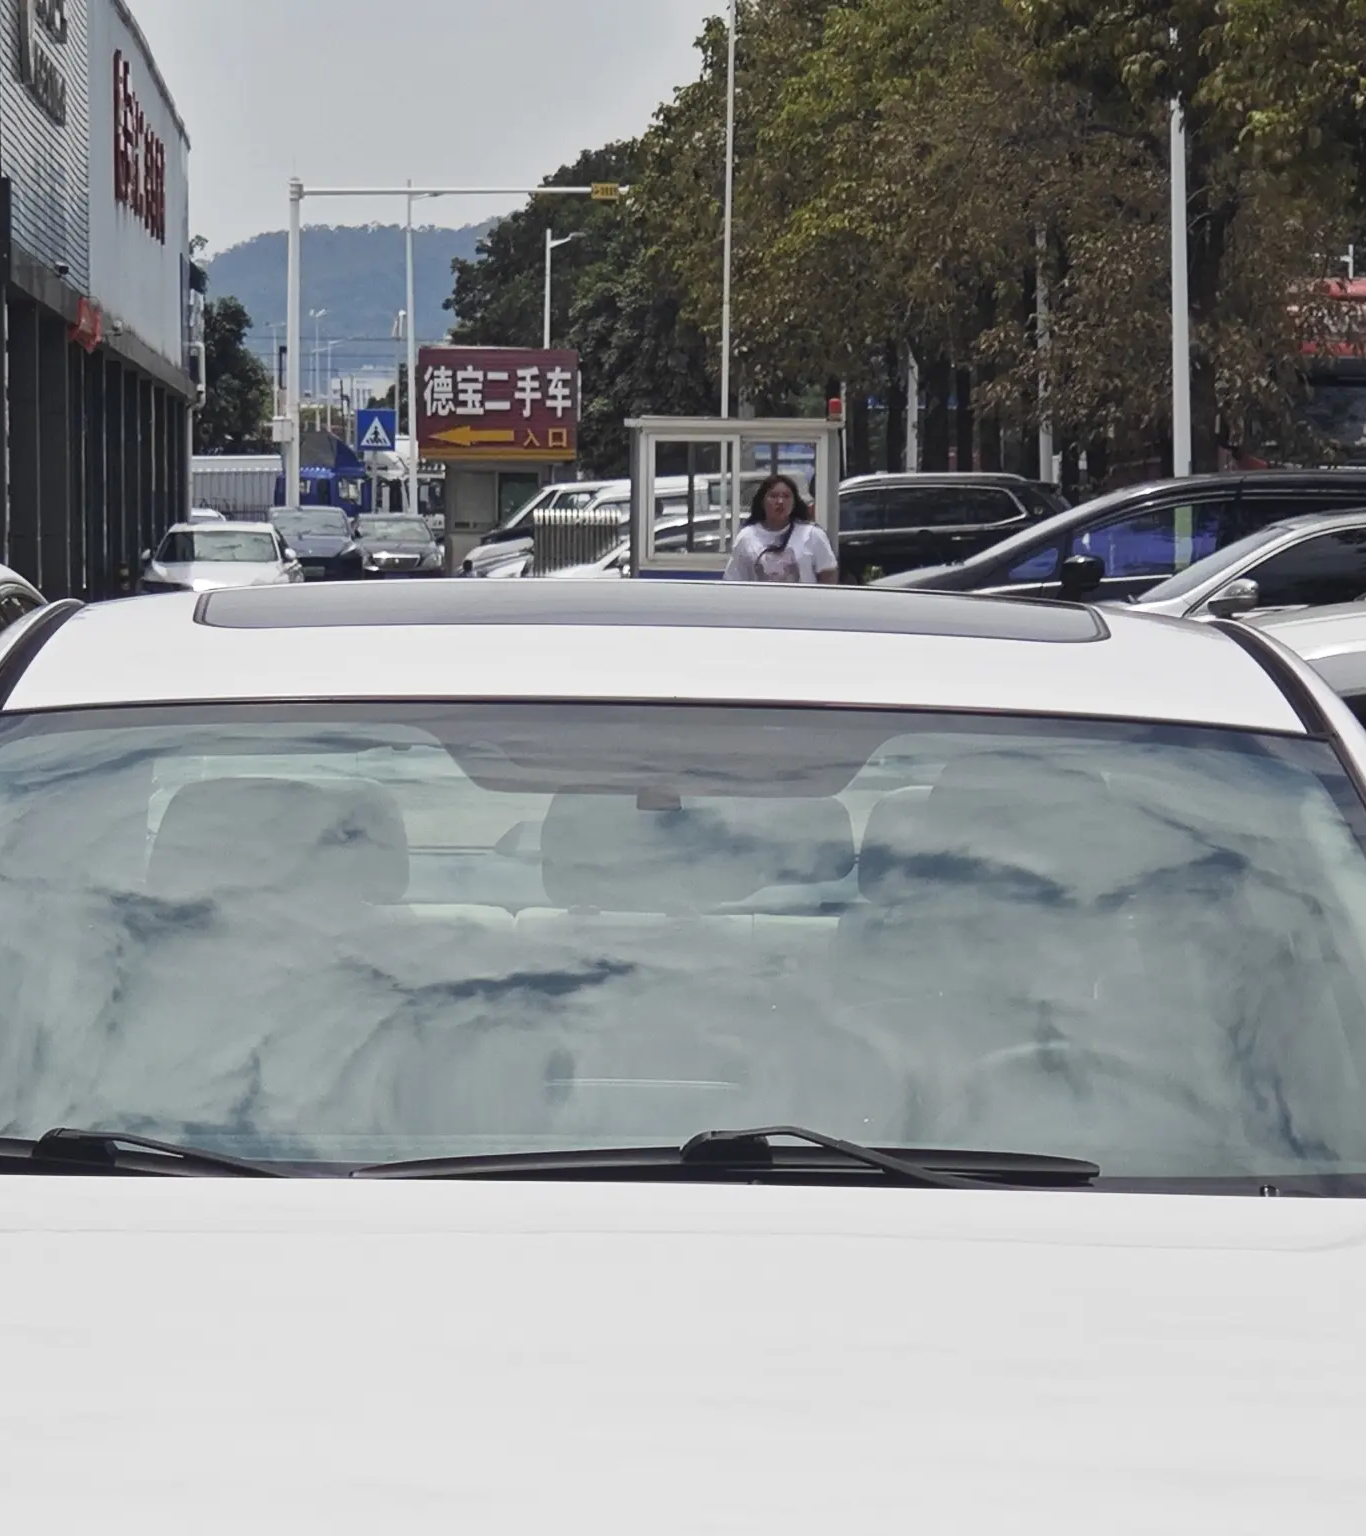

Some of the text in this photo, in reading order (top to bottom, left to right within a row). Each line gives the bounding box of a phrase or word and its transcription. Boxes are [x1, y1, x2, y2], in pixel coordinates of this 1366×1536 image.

[423, 365, 572, 418] 德宝二手车
[523, 428, 567, 447] 入口
